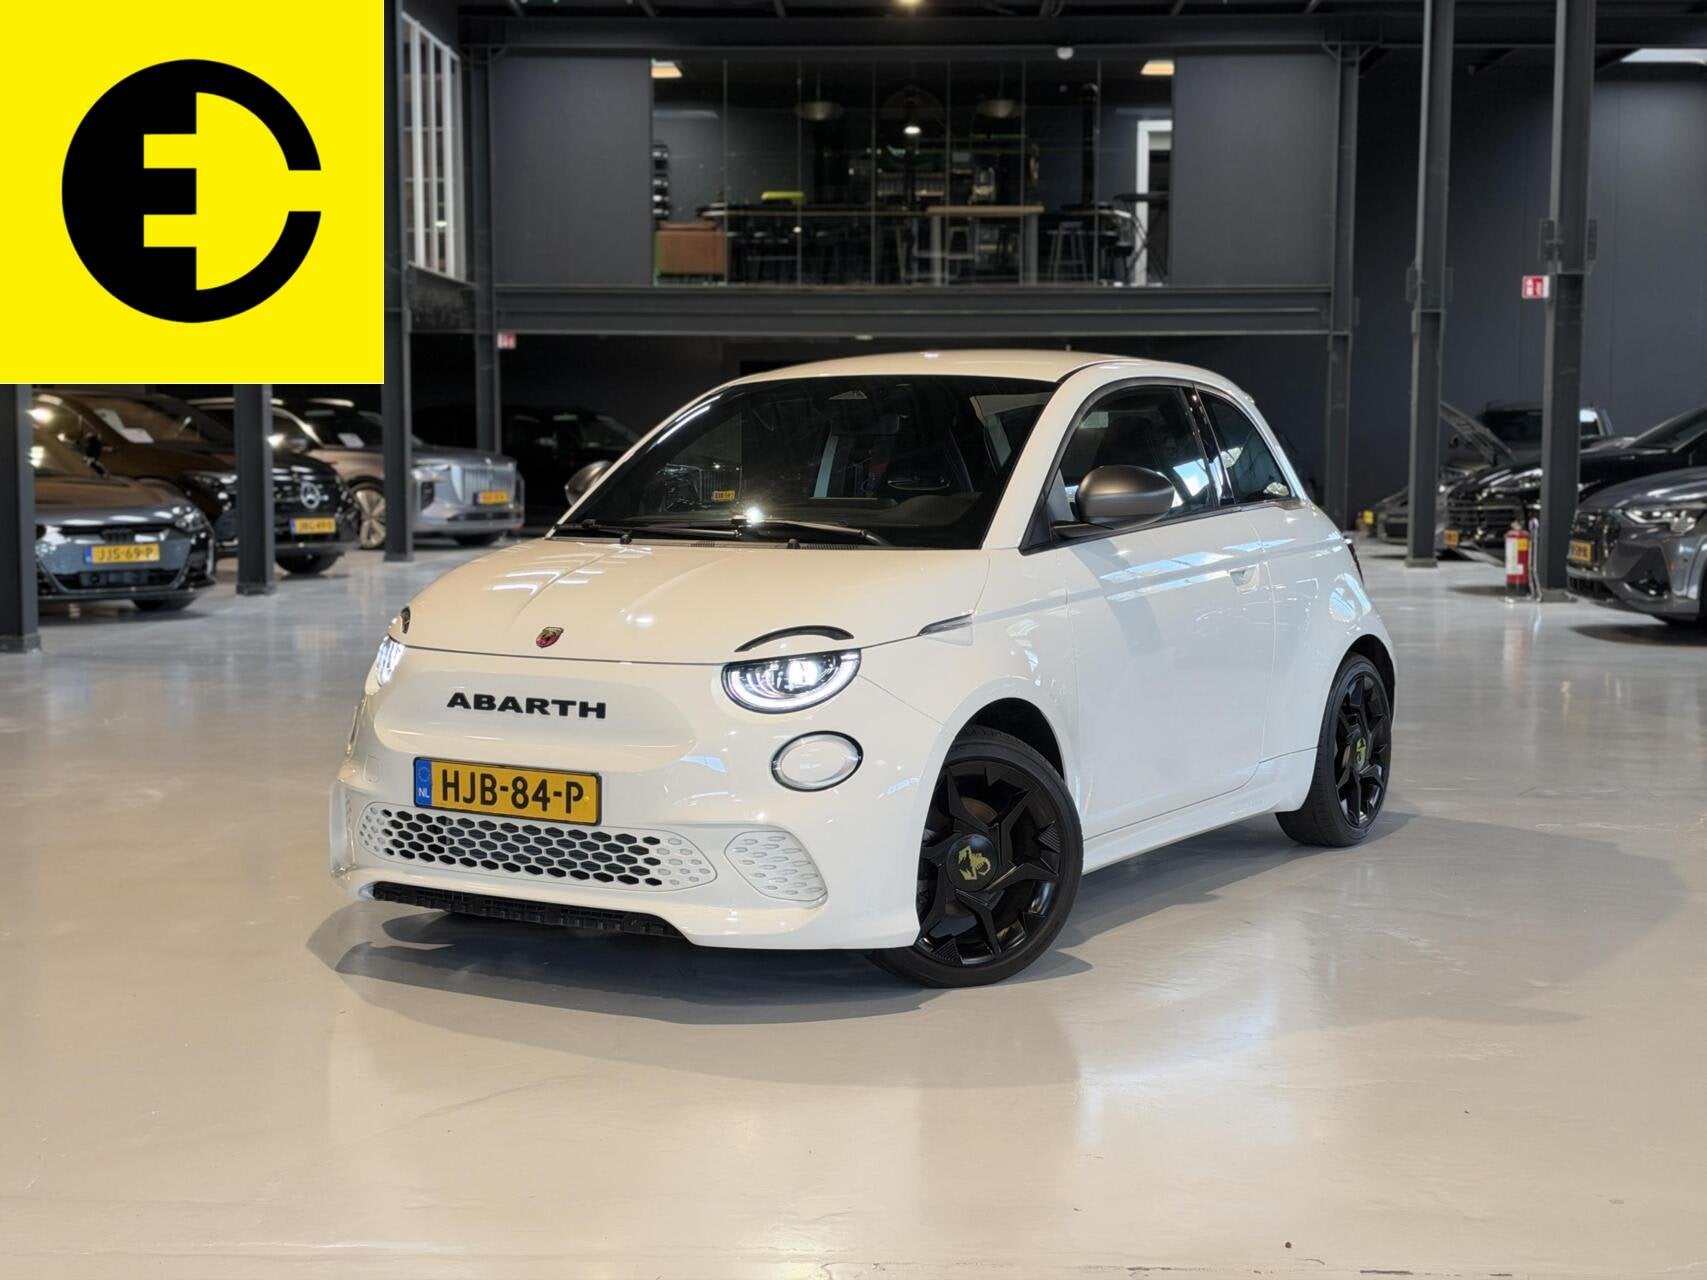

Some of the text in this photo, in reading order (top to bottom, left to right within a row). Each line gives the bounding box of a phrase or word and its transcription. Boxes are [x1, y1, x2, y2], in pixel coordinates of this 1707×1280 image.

[98, 547, 154, 562] JJS-69-P
[446, 692, 606, 719] ABARTH
[418, 787, 430, 799] NL
[442, 769, 584, 814] HJB-84-P
